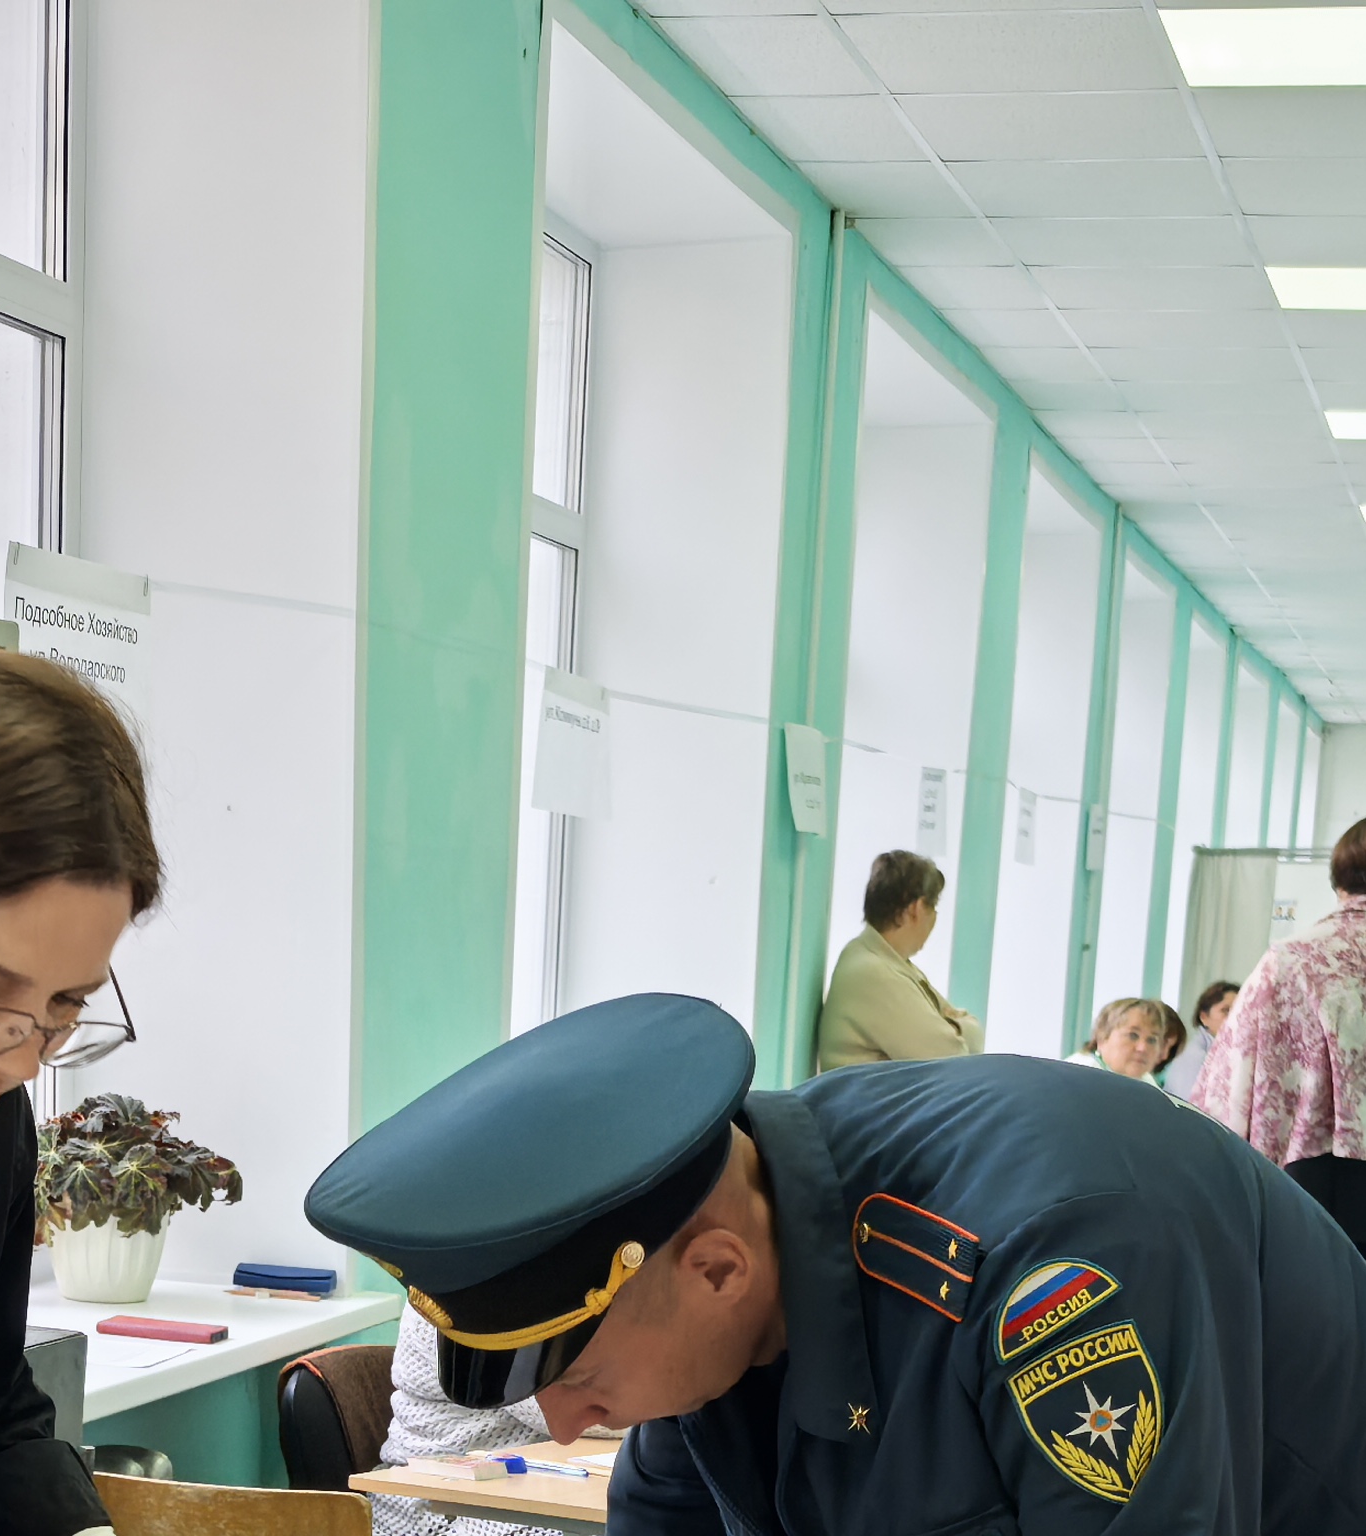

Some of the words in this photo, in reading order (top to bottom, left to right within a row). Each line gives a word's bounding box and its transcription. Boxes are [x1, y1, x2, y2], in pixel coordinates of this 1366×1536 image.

[14, 596, 85, 632] Подсобное
[87, 612, 138, 644] Хозяйство
[1020, 1288, 1092, 1341] РОССИЯ
[1017, 1361, 1058, 1399] МЧС
[1055, 1330, 1135, 1374] РОССИИ
